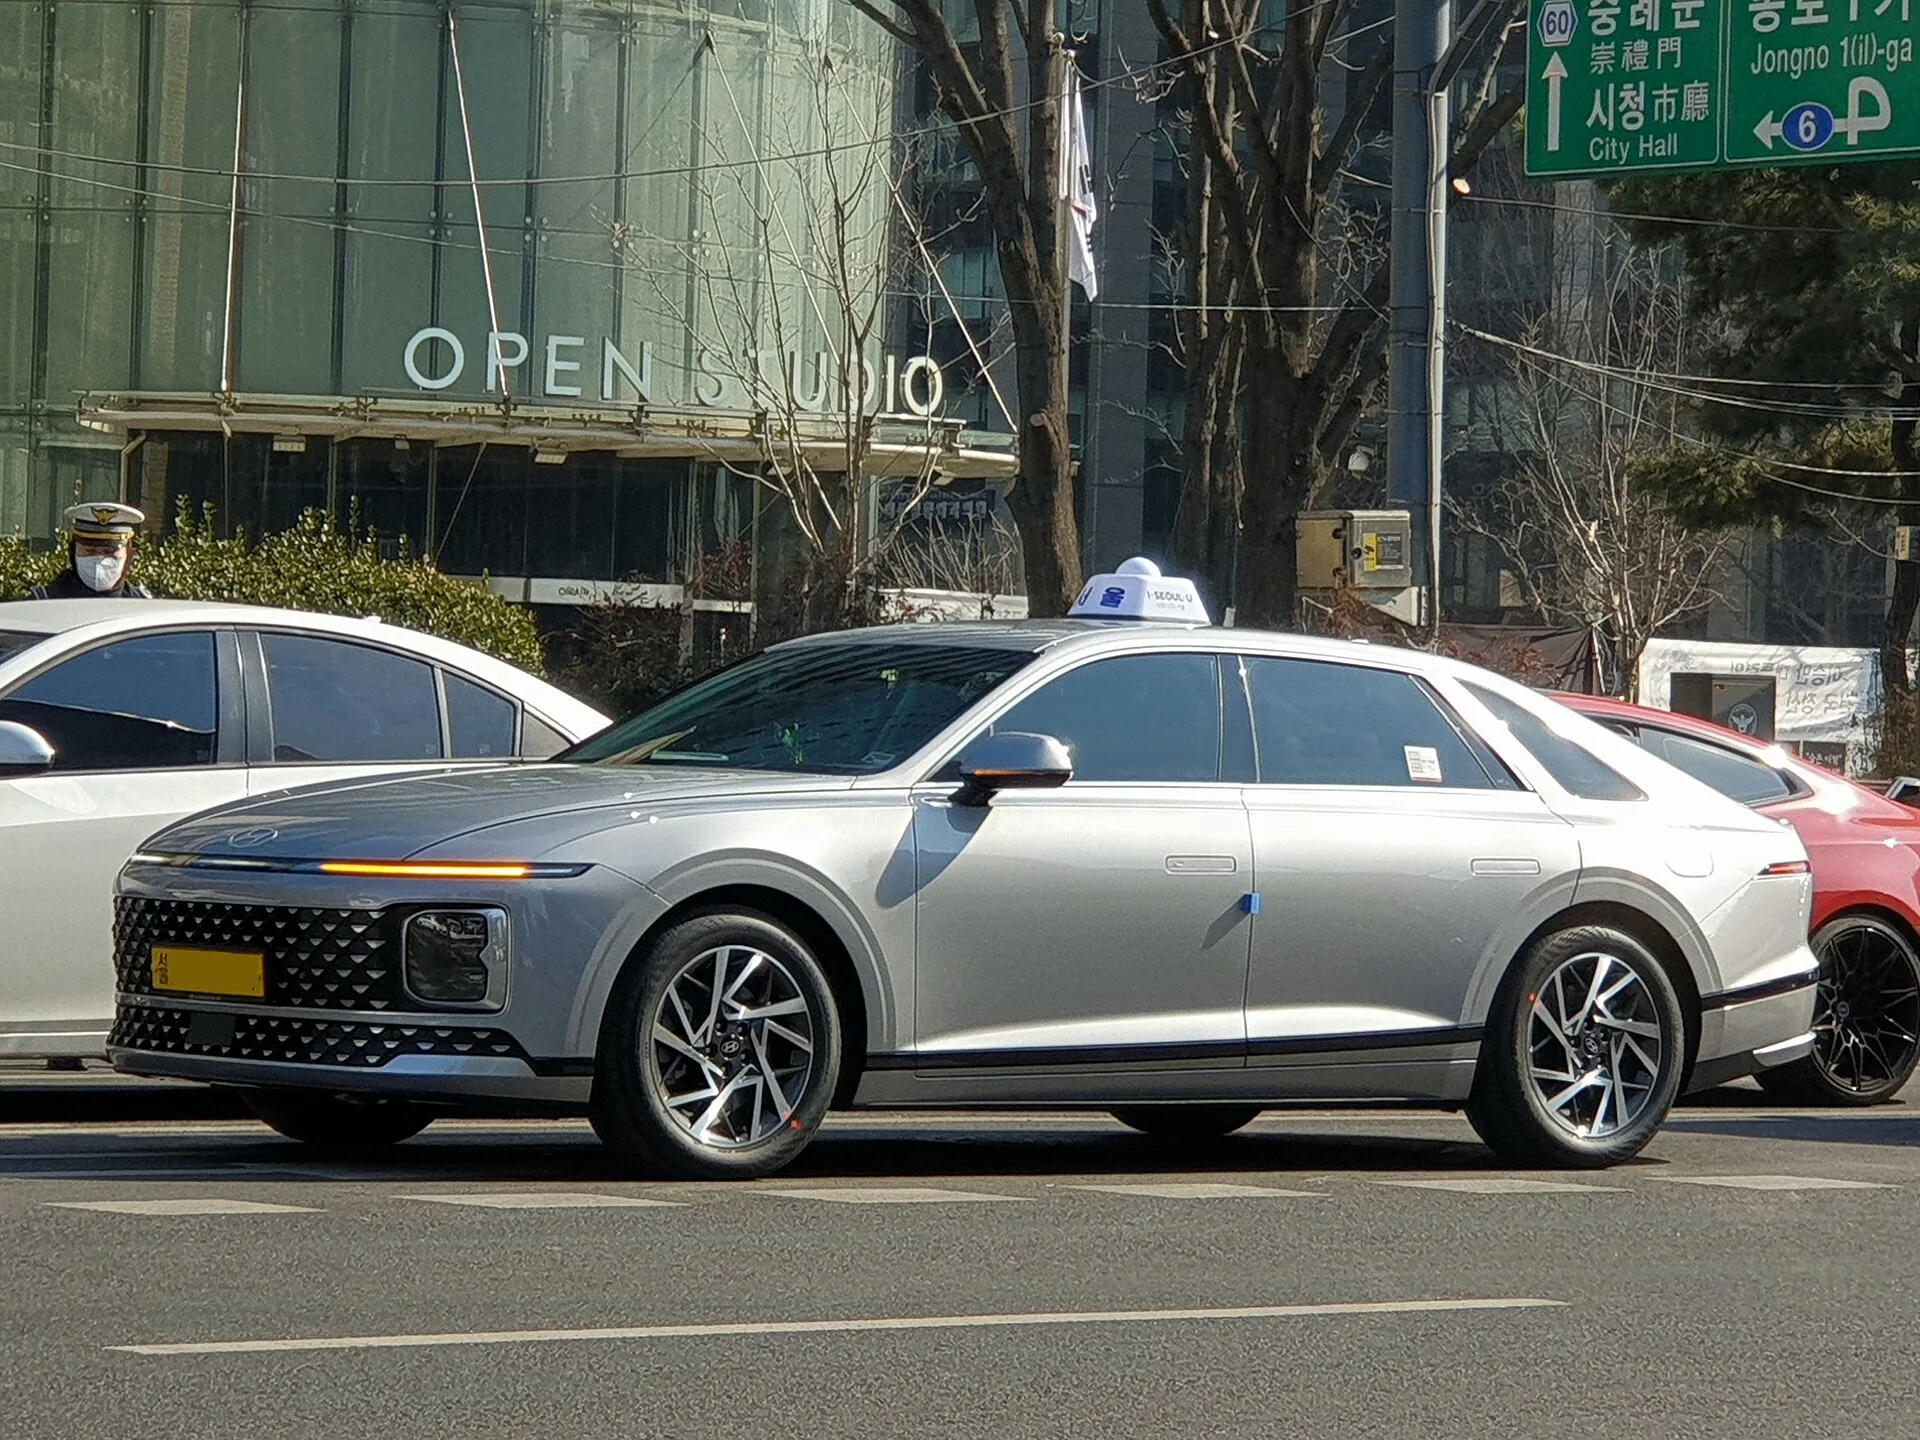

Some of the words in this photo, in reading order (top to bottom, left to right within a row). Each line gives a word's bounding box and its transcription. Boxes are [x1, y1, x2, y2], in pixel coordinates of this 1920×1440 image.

[1546, 9, 1569, 36] 60
[1590, 36, 1682, 75] 崇禮門
[1751, 42, 1830, 80] Jongno
[1840, 32, 1913, 72] 1(il)-ga
[1586, 80, 1645, 131] 시청
[1798, 110, 1817, 143] 6
[1589, 136, 1630, 165] City
[1639, 132, 1678, 158] Hall
[404, 326, 653, 404] OPEN
[694, 347, 944, 417] STUDIO
